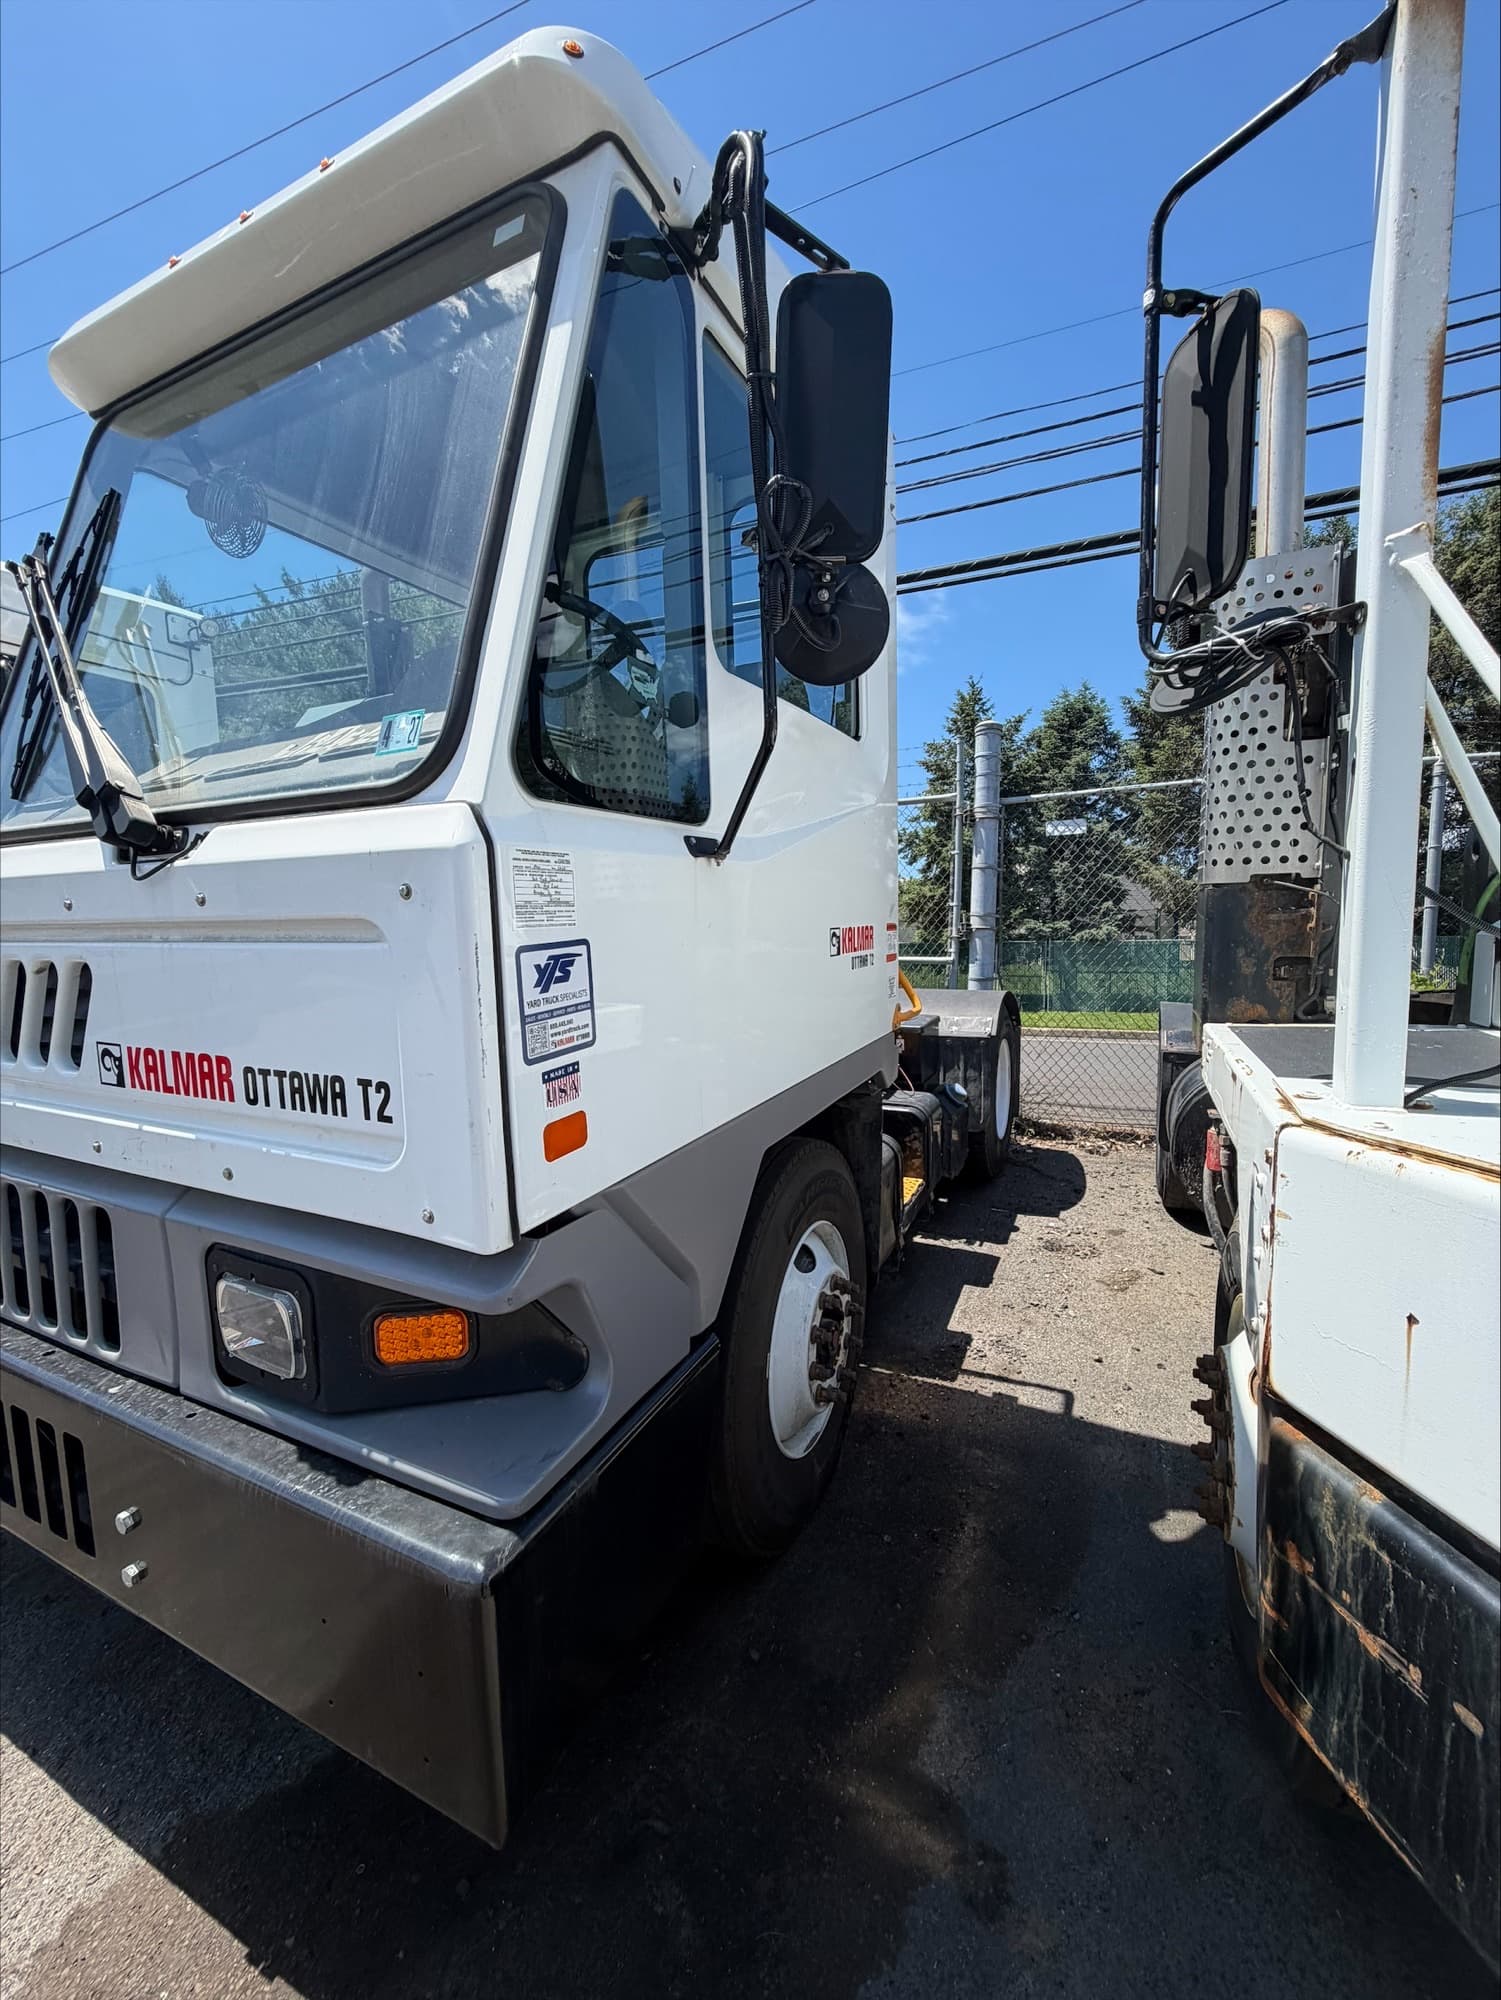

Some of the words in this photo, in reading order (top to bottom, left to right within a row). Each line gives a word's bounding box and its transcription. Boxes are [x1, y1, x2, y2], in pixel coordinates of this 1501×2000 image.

[382, 720, 393, 748] 4
[407, 715, 421, 744] 27
[841, 925, 874, 955] KALMAR
[533, 953, 583, 994] YTS
[526, 998, 541, 1009] YARD
[542, 994, 560, 1006] TRUCK
[560, 988, 588, 1002] SPECIALISTS
[127, 1046, 235, 1103] KALMAR
[242, 1066, 348, 1118] OTTAWA
[356, 1078, 393, 1124] T2
[550, 1067, 565, 1078] MADE
[546, 1079, 579, 1103] USA
